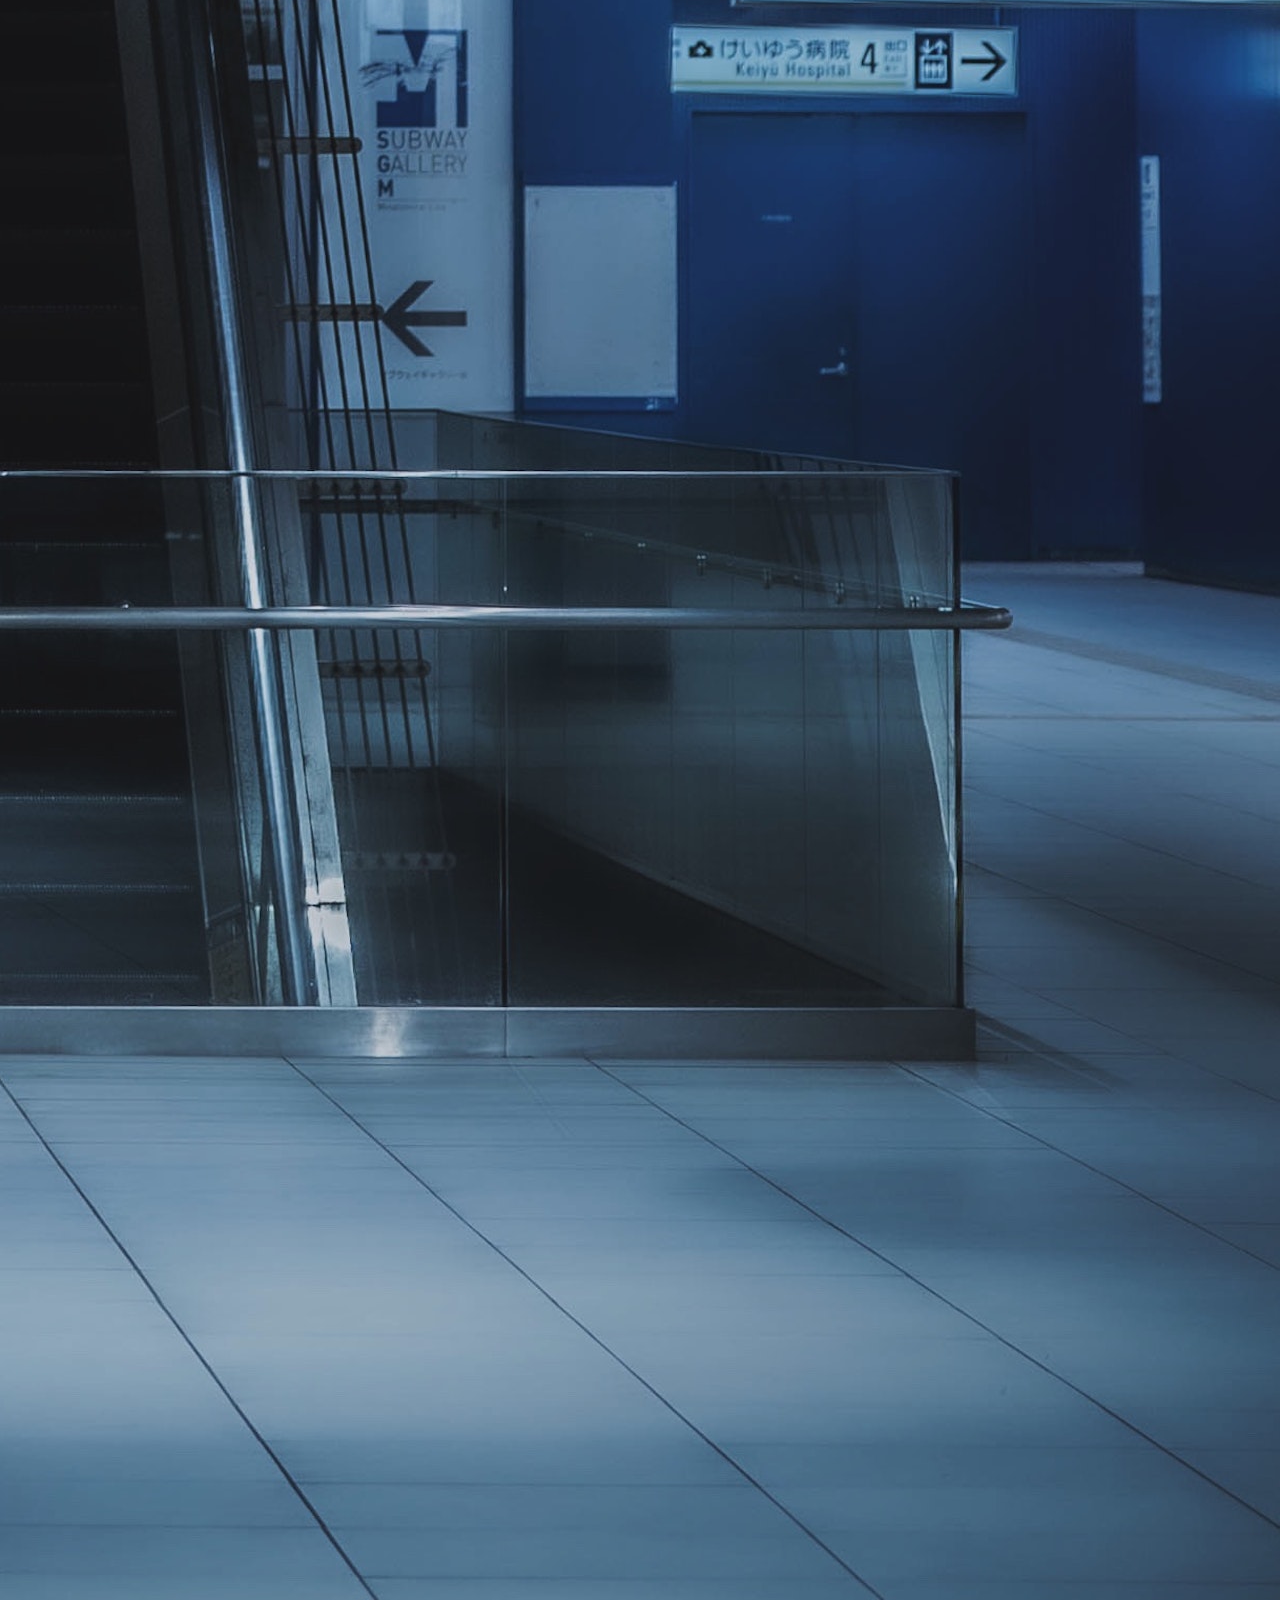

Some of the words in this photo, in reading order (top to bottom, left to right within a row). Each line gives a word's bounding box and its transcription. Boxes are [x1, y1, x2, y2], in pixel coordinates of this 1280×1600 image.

[720, 38, 851, 60] けいゆう病院
[860, 42, 877, 74] 4
[786, 63, 851, 80] Hospital
[376, 129, 469, 150] SUBWAY
[377, 154, 468, 174] GALLERY
[377, 179, 395, 197] M
